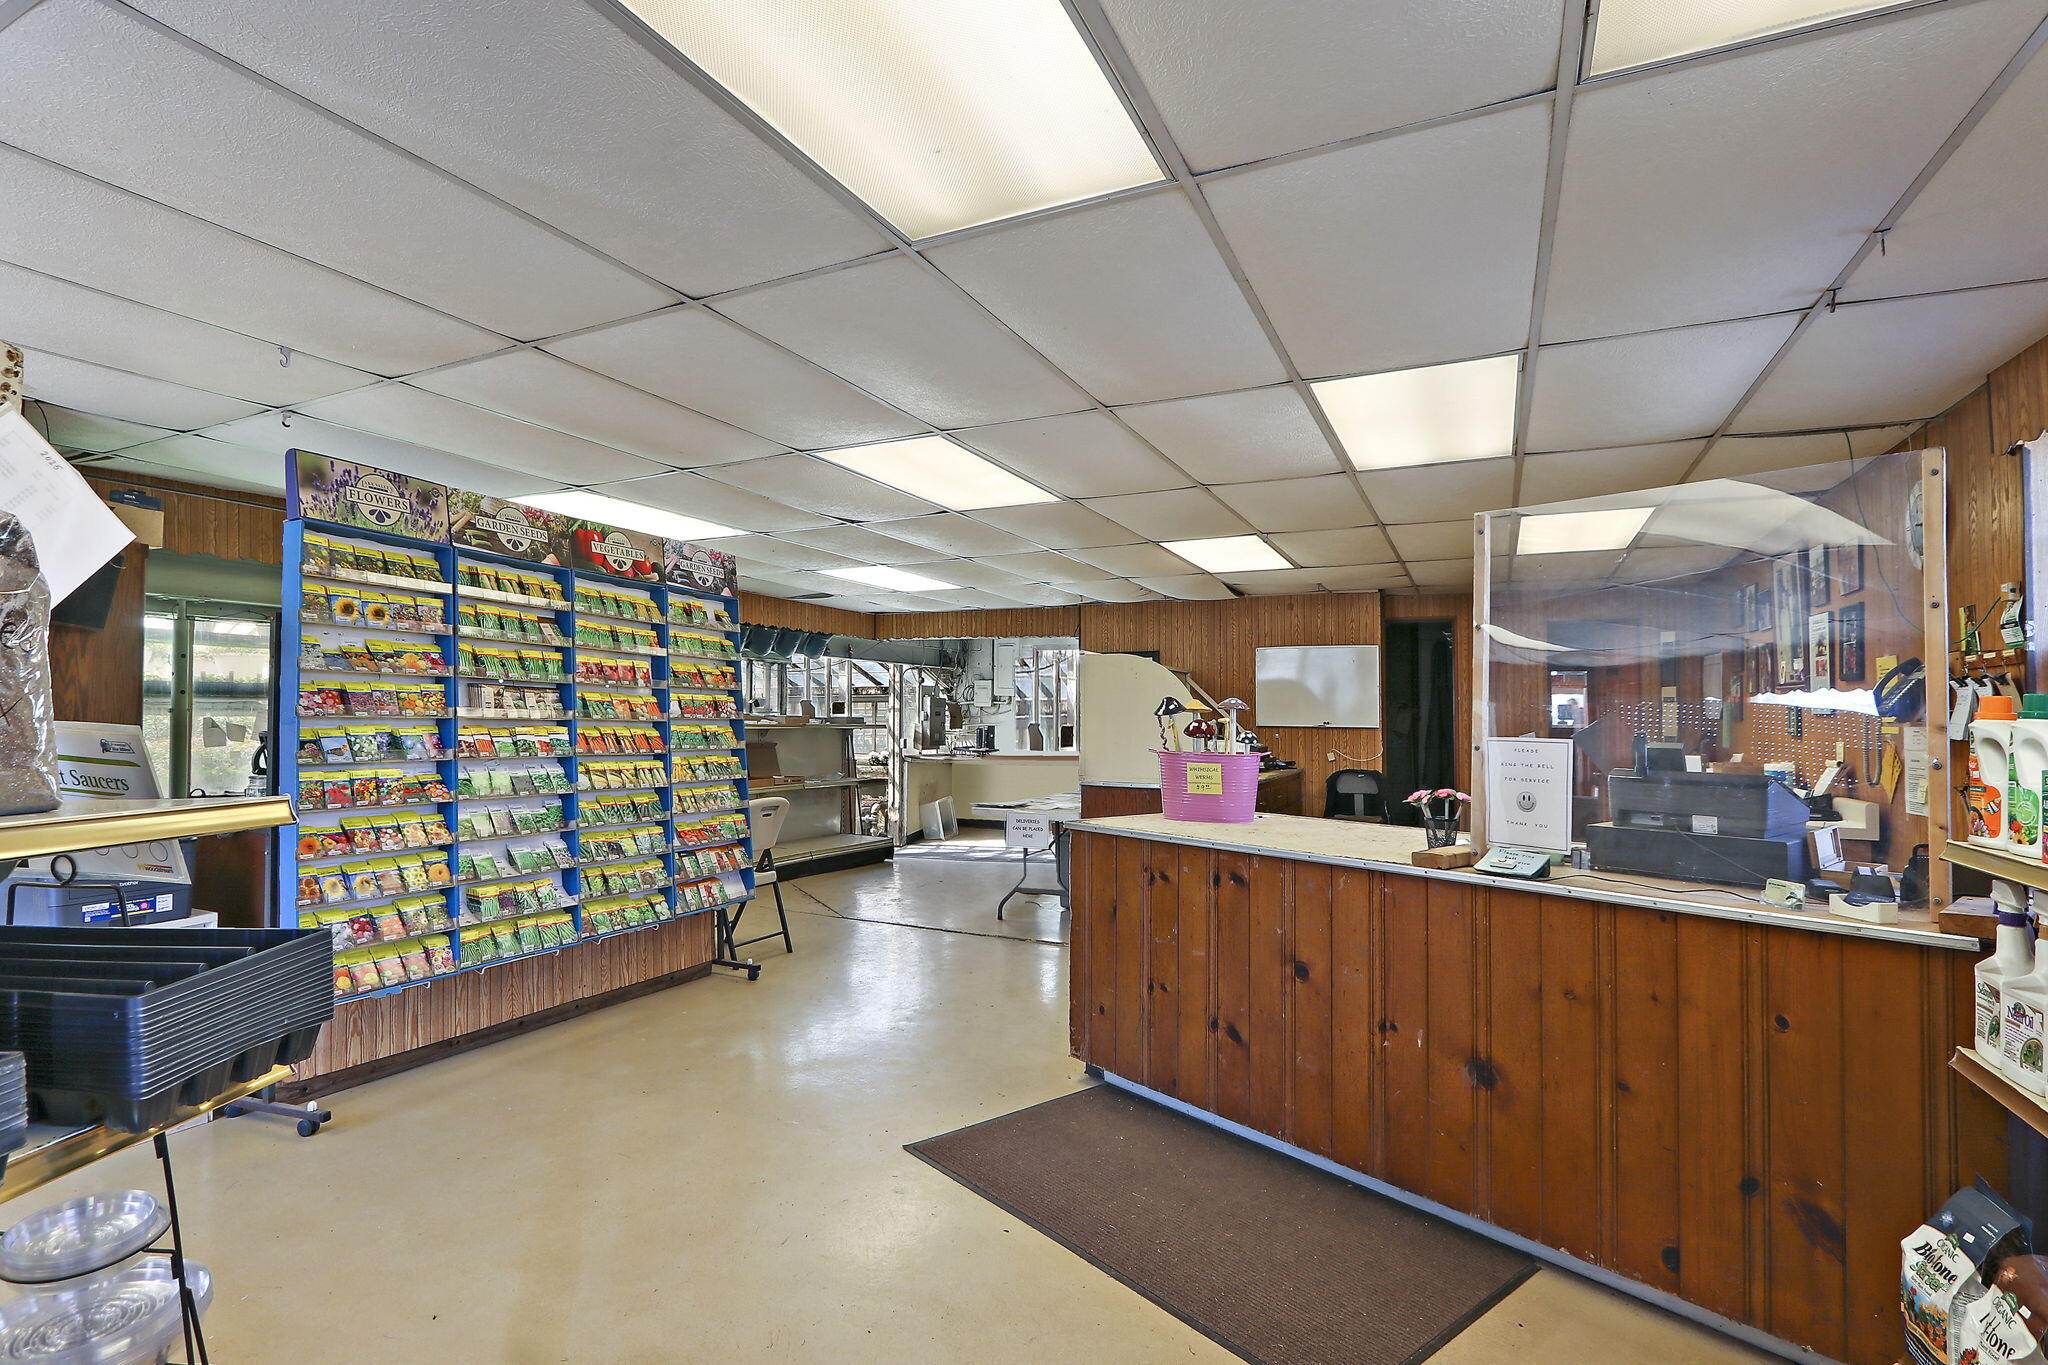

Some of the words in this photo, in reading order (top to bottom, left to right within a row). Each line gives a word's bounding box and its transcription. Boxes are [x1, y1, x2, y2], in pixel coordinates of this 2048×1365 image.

[348, 489, 408, 511] FLOWERS
[477, 517, 519, 535] GARDEN
[520, 528, 547, 541] SEEDS
[593, 543, 644, 560] VEGETABLES
[680, 560, 705, 574] GARDEN
[706, 566, 724, 577] SEEDS
[69, 769, 130, 791] Saucers
